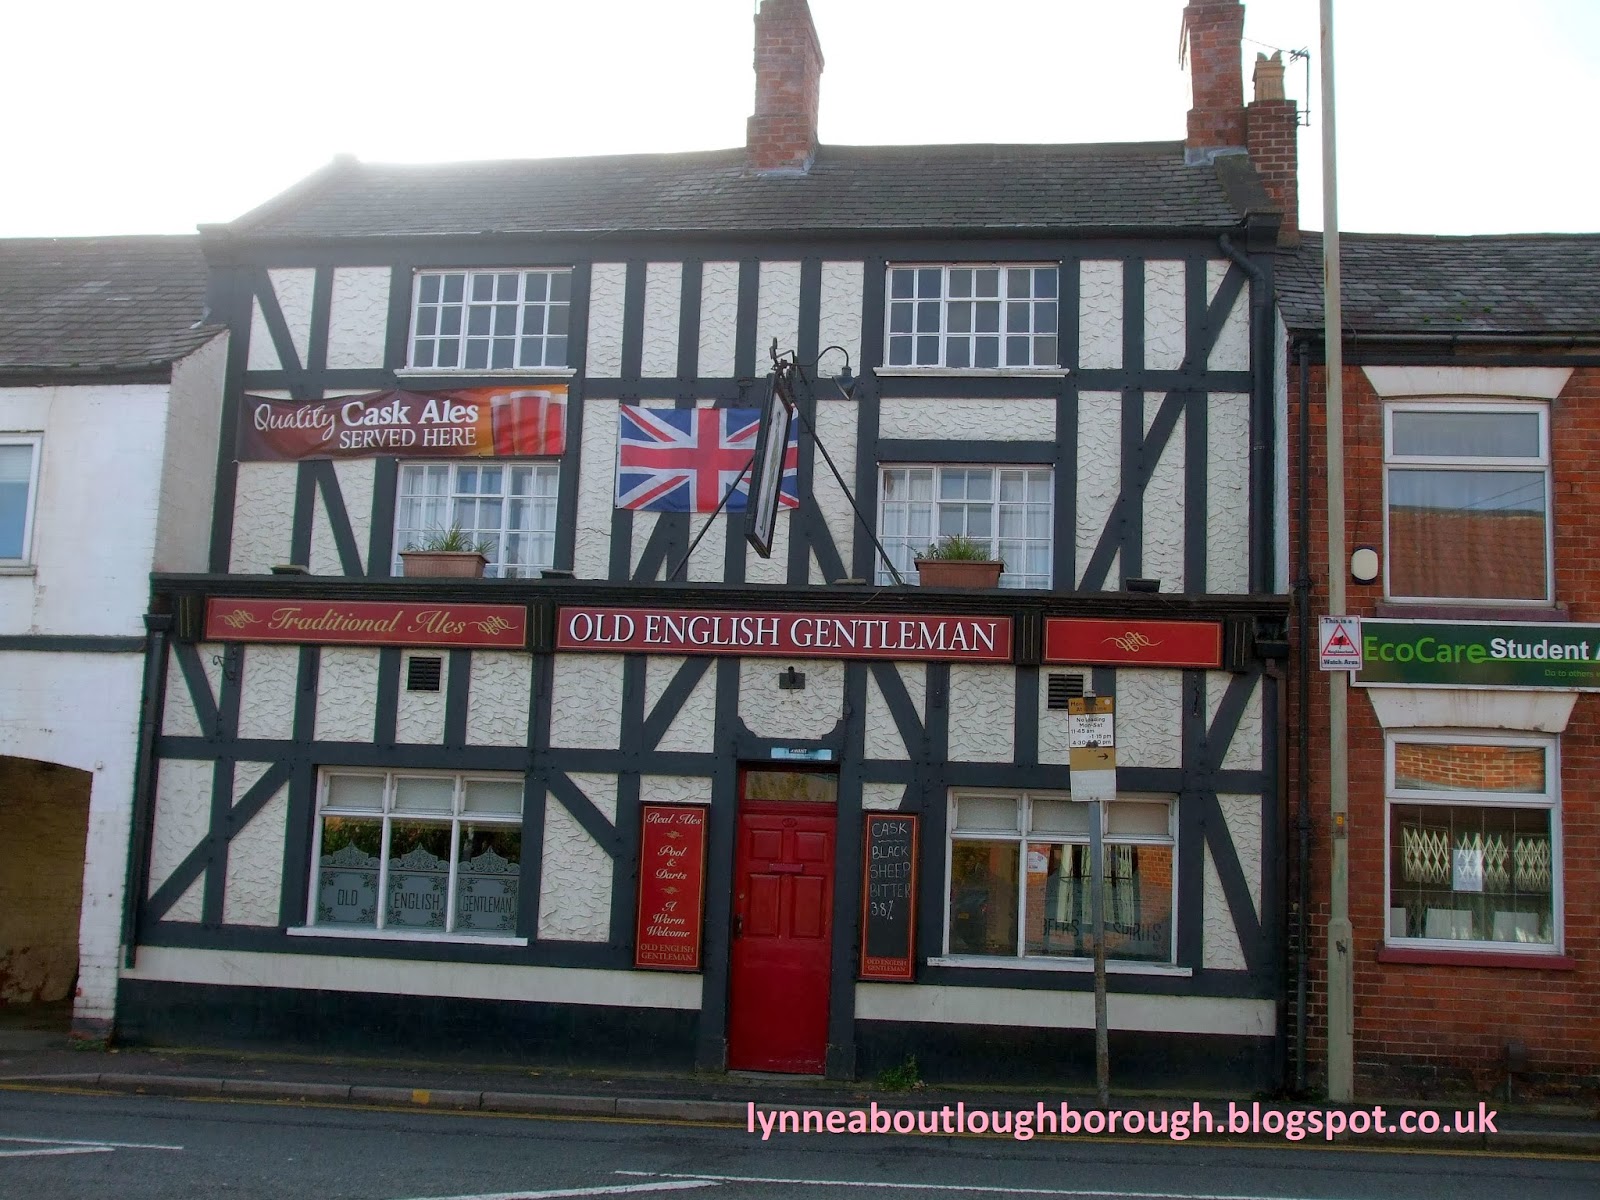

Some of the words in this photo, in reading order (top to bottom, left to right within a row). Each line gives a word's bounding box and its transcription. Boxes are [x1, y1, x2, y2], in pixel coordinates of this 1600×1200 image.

[254, 404, 336, 440] Quality
[342, 399, 410, 427] Cask
[418, 399, 479, 424] Ales
[339, 428, 416, 449] SERVED
[422, 427, 477, 447] HERE
[268, 607, 403, 633] Traditional
[407, 610, 467, 635] Ales
[569, 613, 635, 642] OLD
[644, 615, 780, 647] ENGLISH
[790, 618, 997, 652] GENTLEMAN
[1363, 636, 1487, 664] EcoCare
[1490, 638, 1590, 660] Student
[1569, 670, 1594, 678] others
[646, 812, 674, 824] Real
[676, 813, 702, 825] Ales
[871, 822, 908, 837] CASK
[657, 845, 687, 857] Pool
[871, 845, 909, 860] BLACK
[666, 858, 677, 867] &
[655, 868, 688, 880] Darts
[869, 861, 911, 879] SHEEP
[869, 882, 911, 898] BITTER
[337, 888, 358, 906] OLD
[394, 891, 440, 911] ENGLISH
[463, 895, 512, 914] GENTLEMAN
[661, 900, 677, 912] A
[652, 913, 685, 925] Warm
[646, 926, 690, 938] Welcome
[640, 943, 658, 951] OLD
[659, 944, 694, 953] ENGLISH
[641, 952, 693, 961] GENTLEMAN
